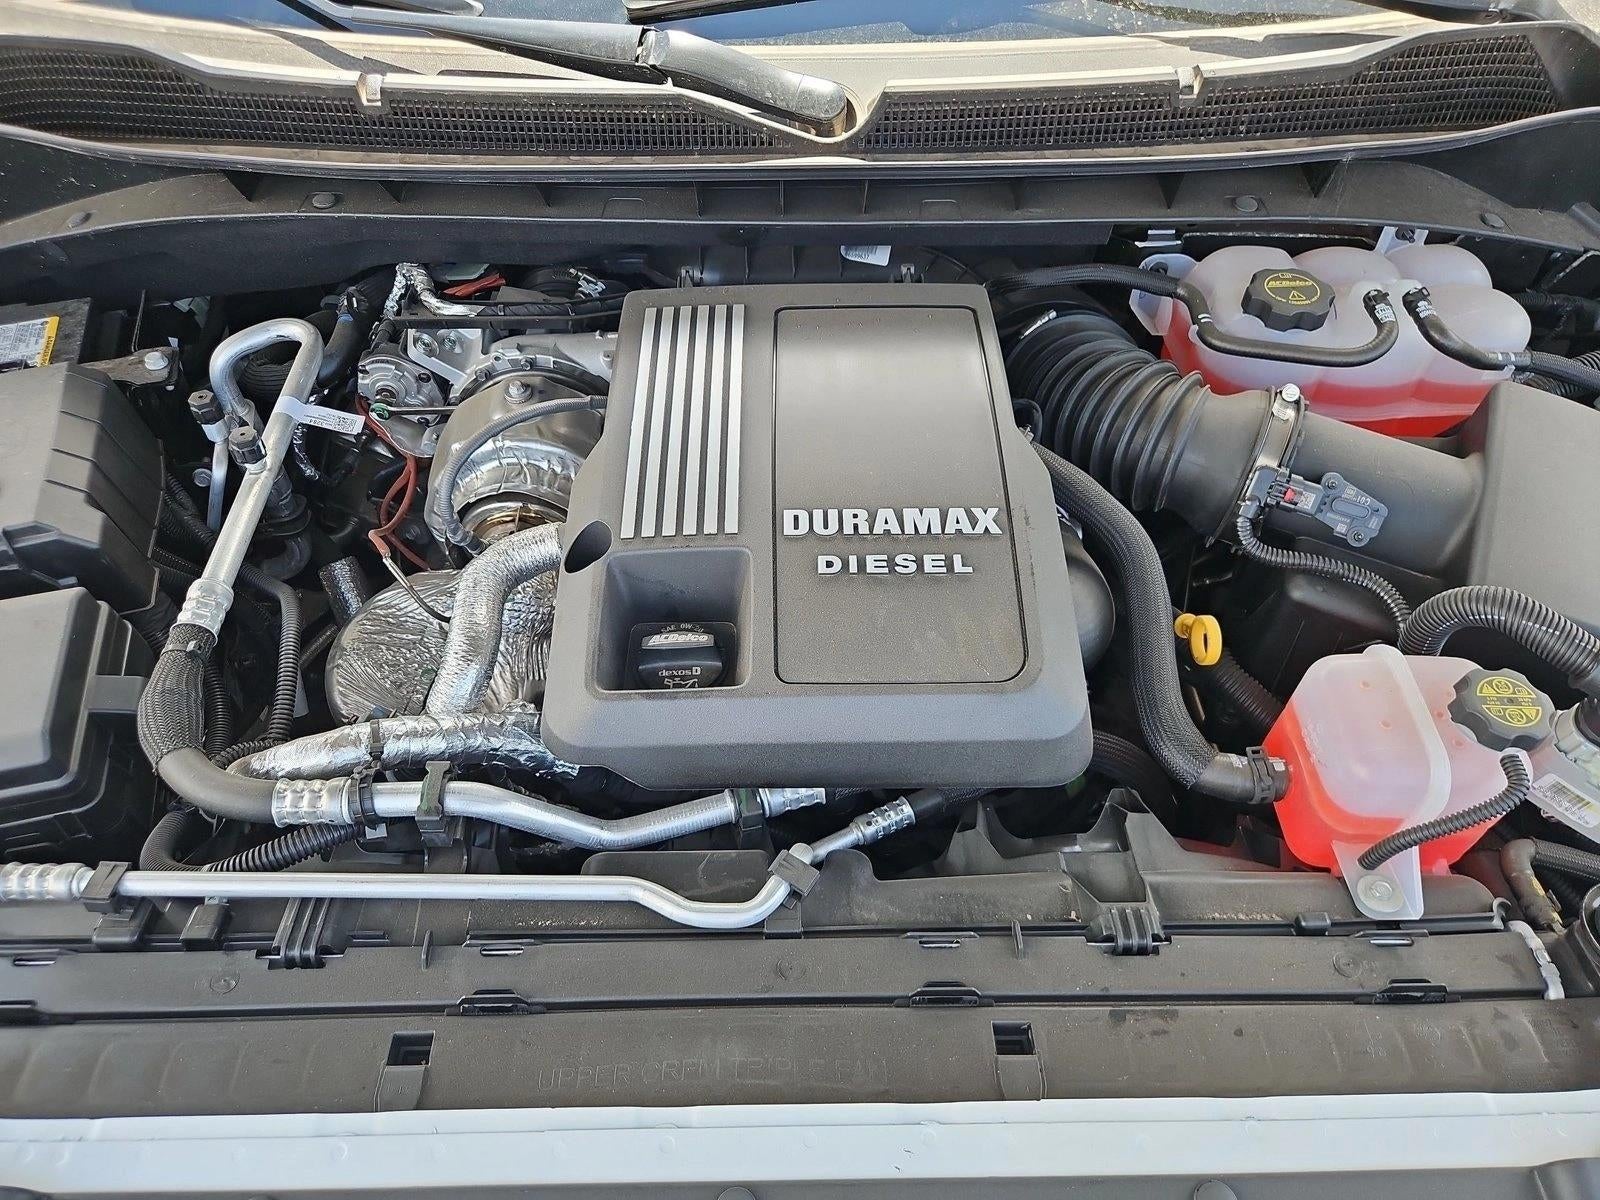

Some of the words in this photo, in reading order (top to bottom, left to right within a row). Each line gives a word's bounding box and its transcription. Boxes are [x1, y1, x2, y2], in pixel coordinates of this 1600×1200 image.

[783, 507, 1003, 536] DURAMAX
[817, 553, 974, 575] DIESEL
[647, 633, 710, 646] ACDelco
[661, 625, 677, 633] SAE
[537, 1063, 632, 1091] UPPER
